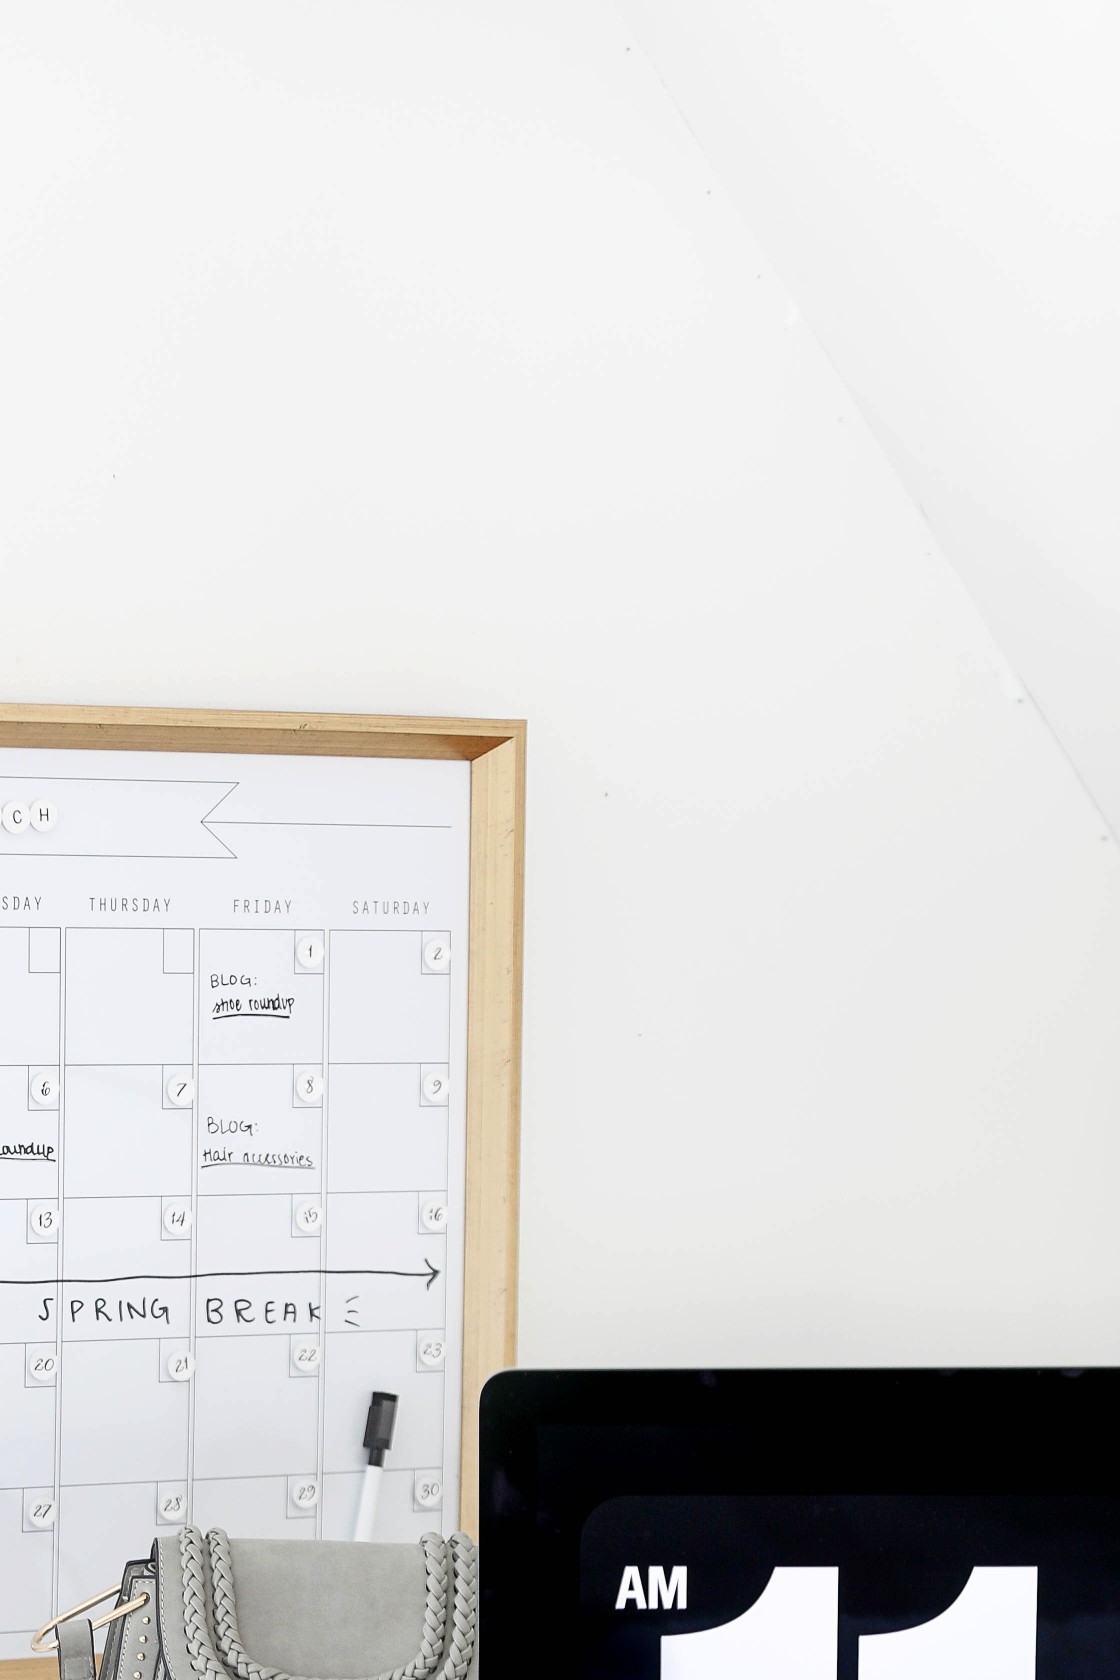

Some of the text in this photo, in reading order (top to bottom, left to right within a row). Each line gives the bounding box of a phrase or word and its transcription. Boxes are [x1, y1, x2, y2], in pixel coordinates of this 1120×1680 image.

[88, 897, 171, 912] THURSDAY
[233, 899, 292, 914] FRIDAY
[352, 900, 430, 915] SATURDAY
[433, 947, 442, 961] 2
[210, 973, 257, 989] BLOG:
[211, 993, 295, 1014] shoe roundup
[40, 1081, 51, 1097] 6
[176, 1082, 188, 1097] 7
[306, 1077, 314, 1094] 8
[432, 1079, 443, 1095] 9
[206, 1116, 258, 1137] BLOG:
[202, 1146, 313, 1167] Hair accessories
[38, 1211, 53, 1229] 13
[171, 1211, 186, 1227] 14
[304, 1207, 318, 1224] 15
[428, 1207, 442, 1222] 16
[38, 1298, 171, 1325] SPRING
[206, 1297, 321, 1325] BREAK
[298, 1348, 317, 1364] 22
[423, 1341, 442, 1357] 23
[34, 1358, 55, 1372] 20
[175, 1356, 188, 1373] 21
[298, 1484, 316, 1501] 29
[421, 1483, 440, 1499] 30
[33, 1504, 53, 1519] 27
[163, 1495, 183, 1512] 28
[615, 1565, 688, 1610] AM
